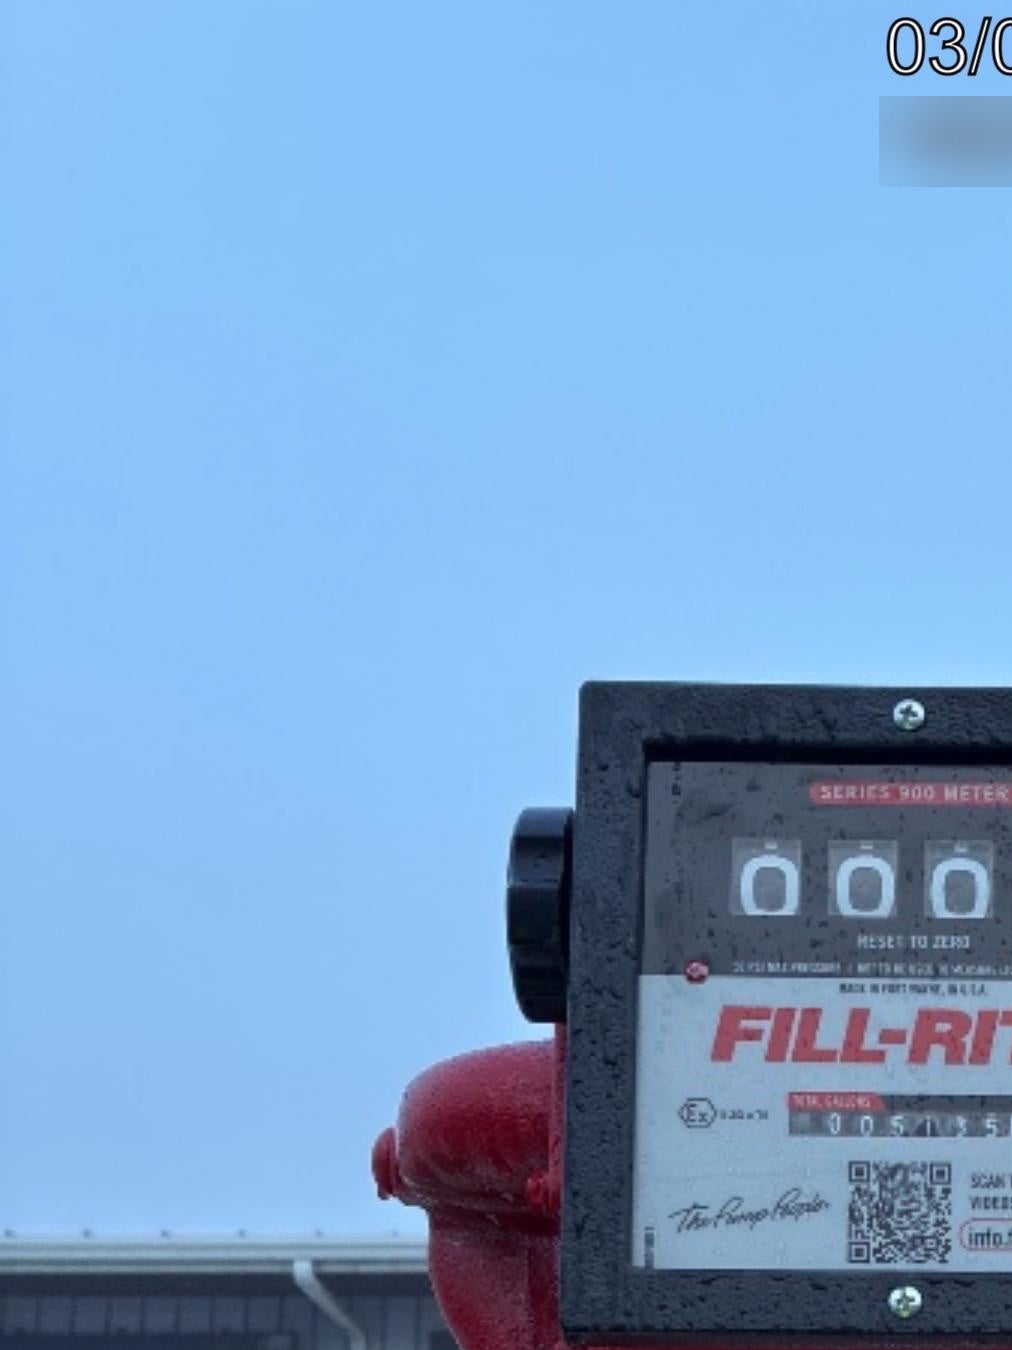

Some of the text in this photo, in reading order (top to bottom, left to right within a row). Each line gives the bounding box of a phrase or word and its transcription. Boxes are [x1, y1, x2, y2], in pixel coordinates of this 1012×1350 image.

[821, 784, 1009, 801] SERIES 900 METER
[911, 936, 927, 949] TO
[933, 936, 971, 949] ZERO
[971, 1174, 1005, 1189] SCAN
